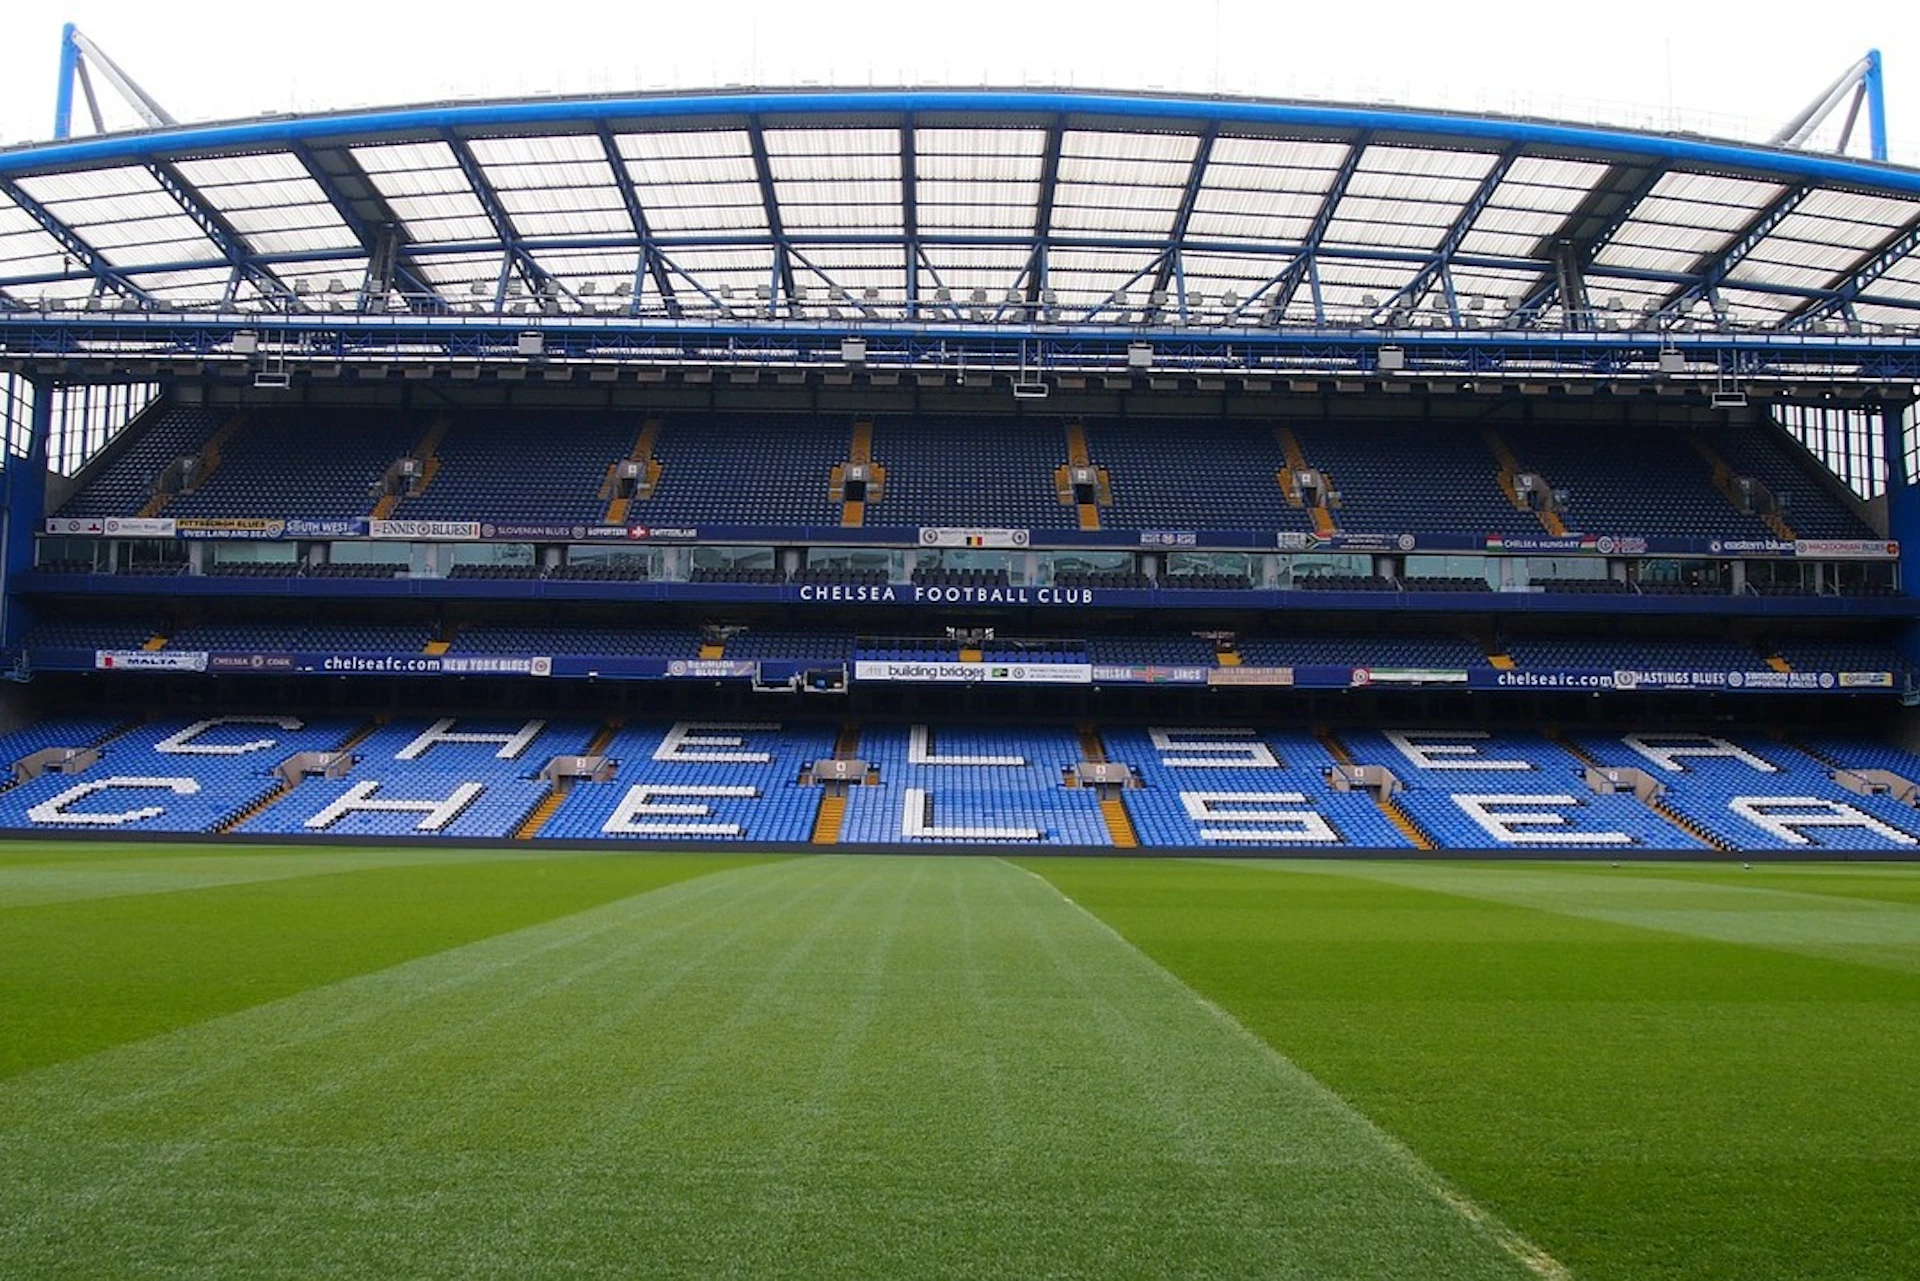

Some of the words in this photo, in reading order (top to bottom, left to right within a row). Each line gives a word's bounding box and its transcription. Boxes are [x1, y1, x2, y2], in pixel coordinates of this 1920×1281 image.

[237, 520, 265, 528] BLUES
[322, 522, 347, 533] WEST
[431, 524, 469, 536] BLUES
[497, 526, 545, 536] SLOVENIAN
[545, 527, 570, 536] BLUES
[1504, 540, 1537, 549] CHELSEA
[1539, 541, 1580, 549] HUNGARY
[1765, 540, 1795, 550] blues
[800, 586, 896, 601] CHELSEA
[915, 588, 1029, 602] FOOTBALL
[1038, 589, 1093, 604] CLUB
[212, 657, 248, 666] CHELSEA
[324, 656, 440, 671] chelseafc.com
[443, 659, 468, 671] NEW
[469, 659, 498, 671] YORK
[888, 665, 936, 679] building
[940, 666, 985, 681] bridges
[1093, 668, 1132, 679] CHELSEA
[1498, 671, 1612, 686] chelseafc.com
[1635, 672, 1689, 684] HASTINGS
[1692, 673, 1725, 685] BLUES
